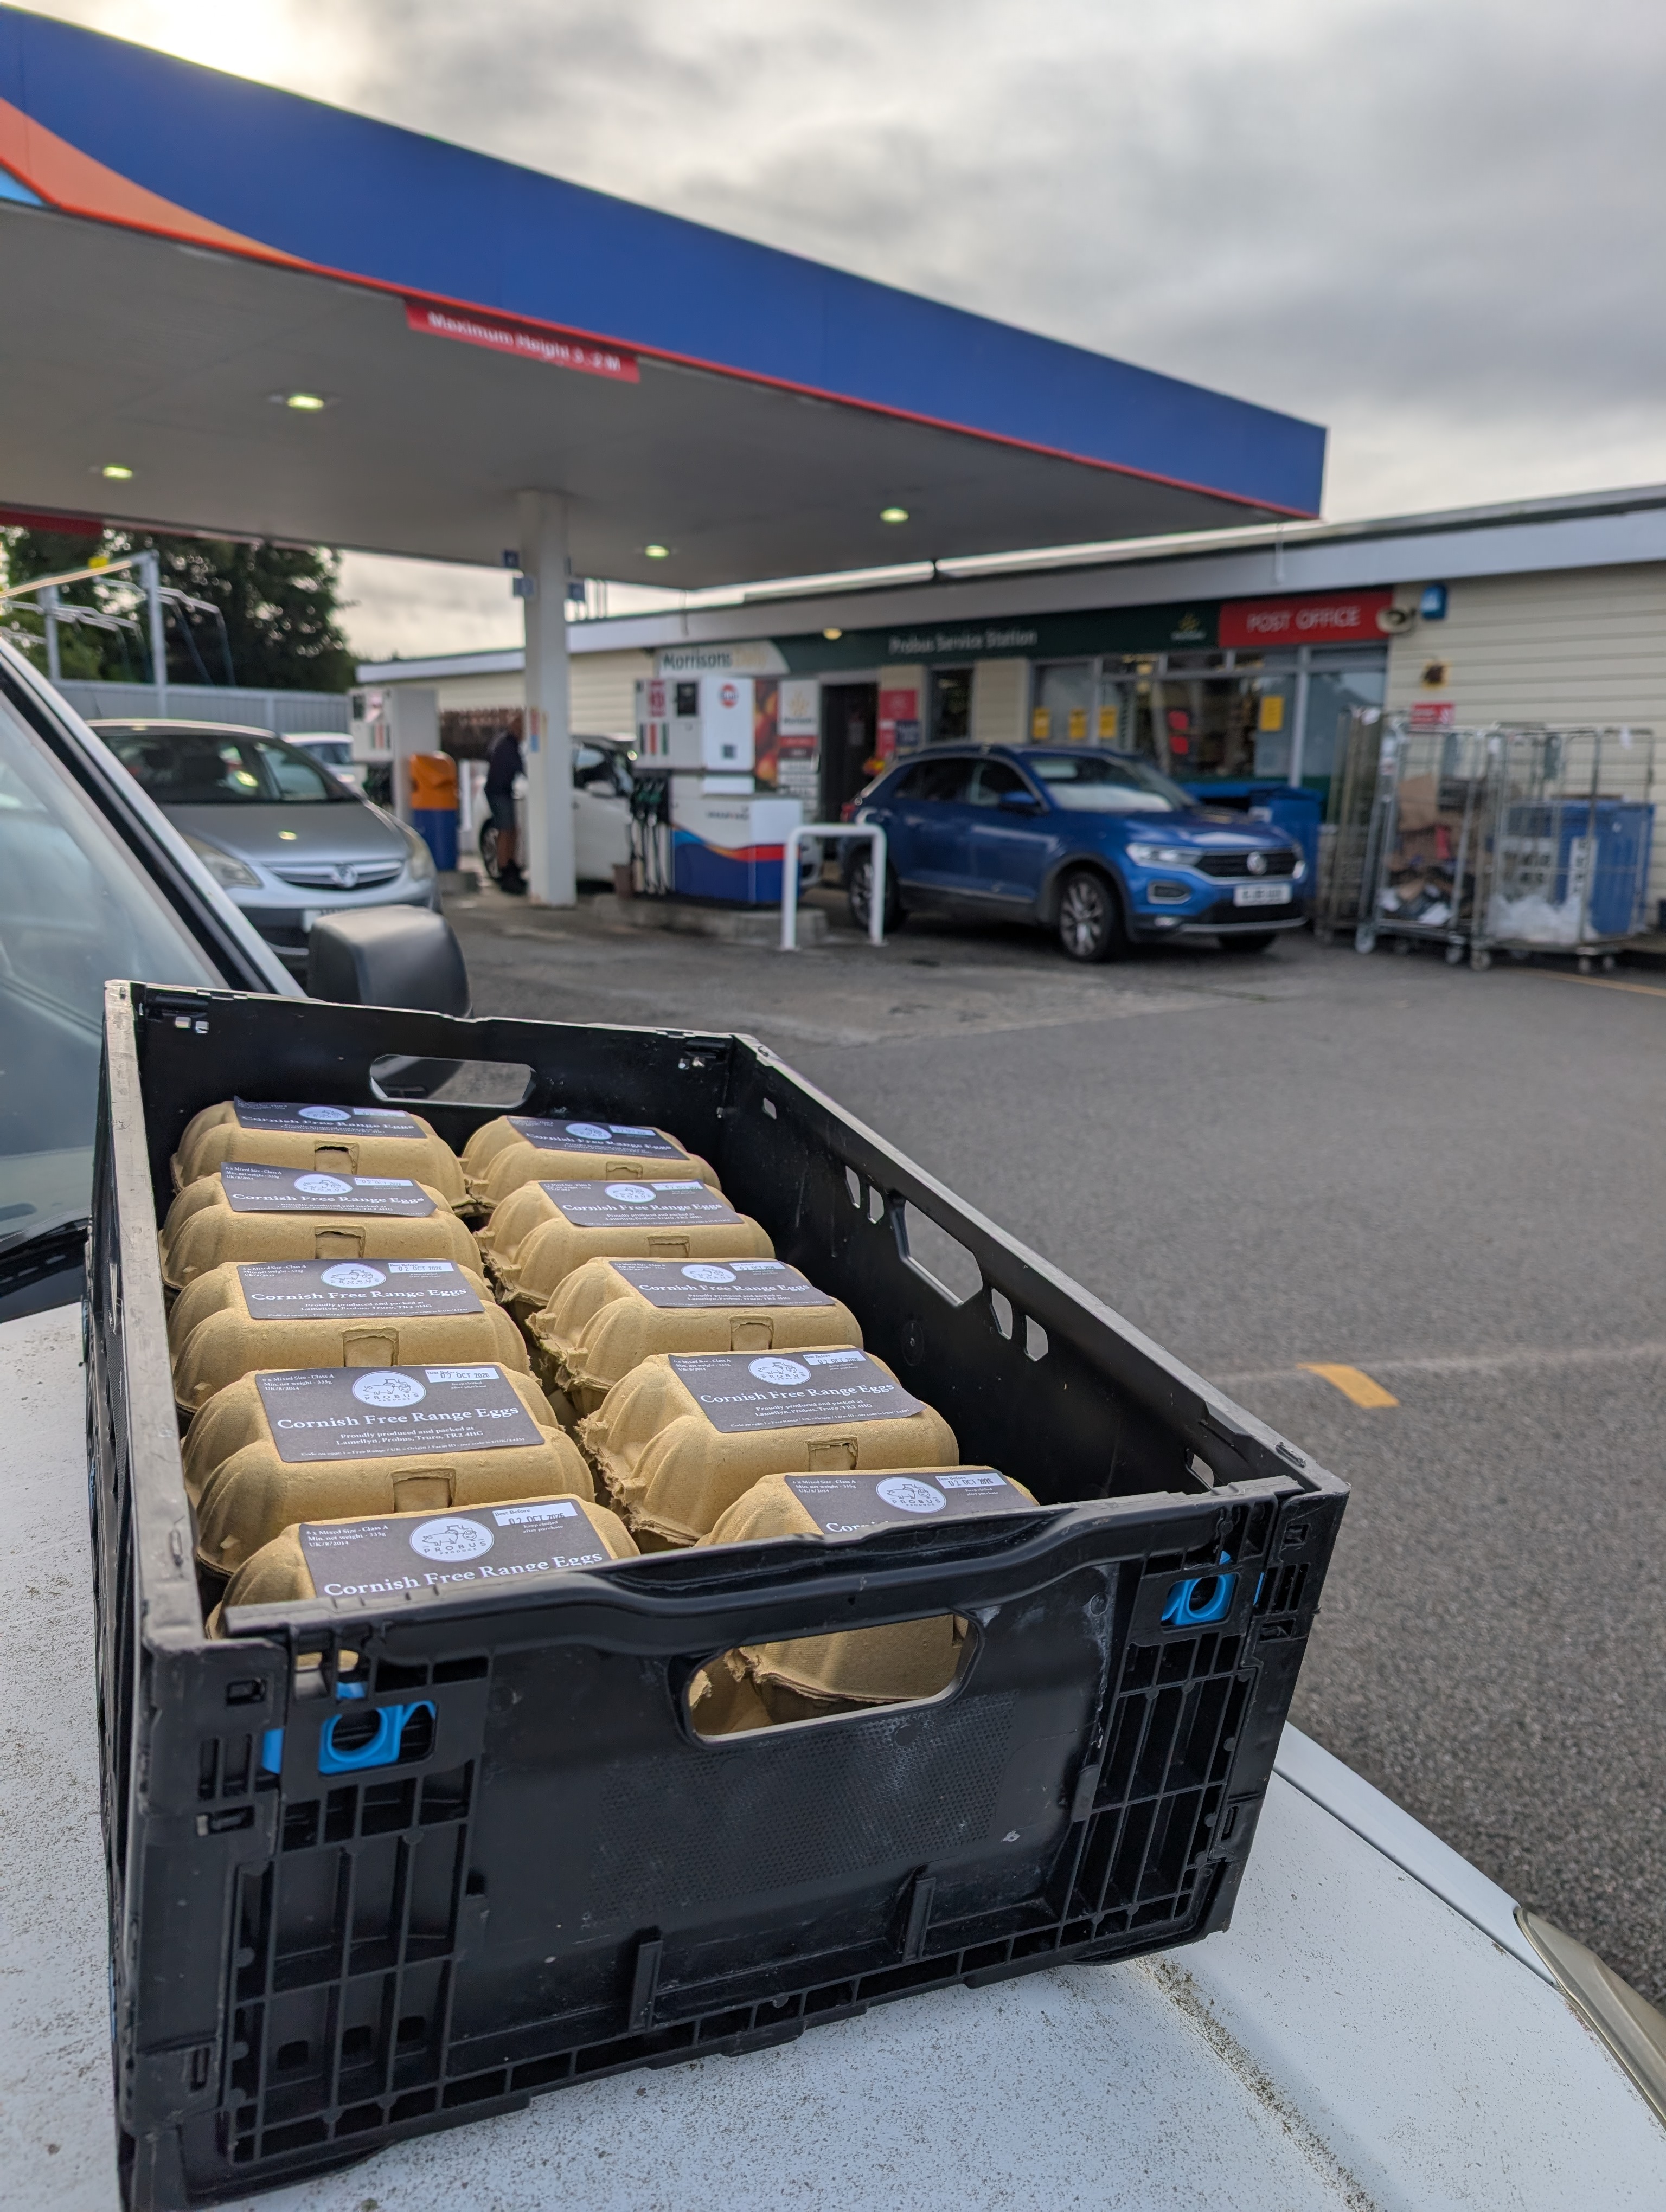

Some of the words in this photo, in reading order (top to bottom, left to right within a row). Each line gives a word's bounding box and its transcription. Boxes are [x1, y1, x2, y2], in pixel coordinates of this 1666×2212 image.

[428, 311, 515, 345] Maximum
[515, 333, 570, 359] Height
[1247, 612, 1291, 633] POST
[1295, 606, 1361, 630] OFFICE
[935, 631, 984, 652] Service
[985, 627, 1038, 649] Station
[663, 652, 731, 671] Morrisons
[650, 1204, 691, 1212] Range
[691, 1203, 722, 1211] Eggs
[700, 1392, 768, 1403] Cornish
[767, 1391, 806, 1399] Free
[805, 1387, 857, 1396] Range
[856, 1383, 894, 1393] Eggs
[785, 1401, 821, 1410] produced
[277, 1416, 360, 1429] Cornish
[363, 1414, 408, 1425] Free
[411, 1411, 472, 1422] Range
[475, 1407, 519, 1418] Eggs
[377, 1430, 416, 1439] produced
[382, 1435, 415, 1443] Probus,
[424, 1541, 486, 1554] PROBUS
[324, 1576, 421, 1596] Cornish
[424, 1571, 476, 1586] Free
[478, 1560, 550, 1578] Range
[552, 1553, 603, 1568] Eggs
